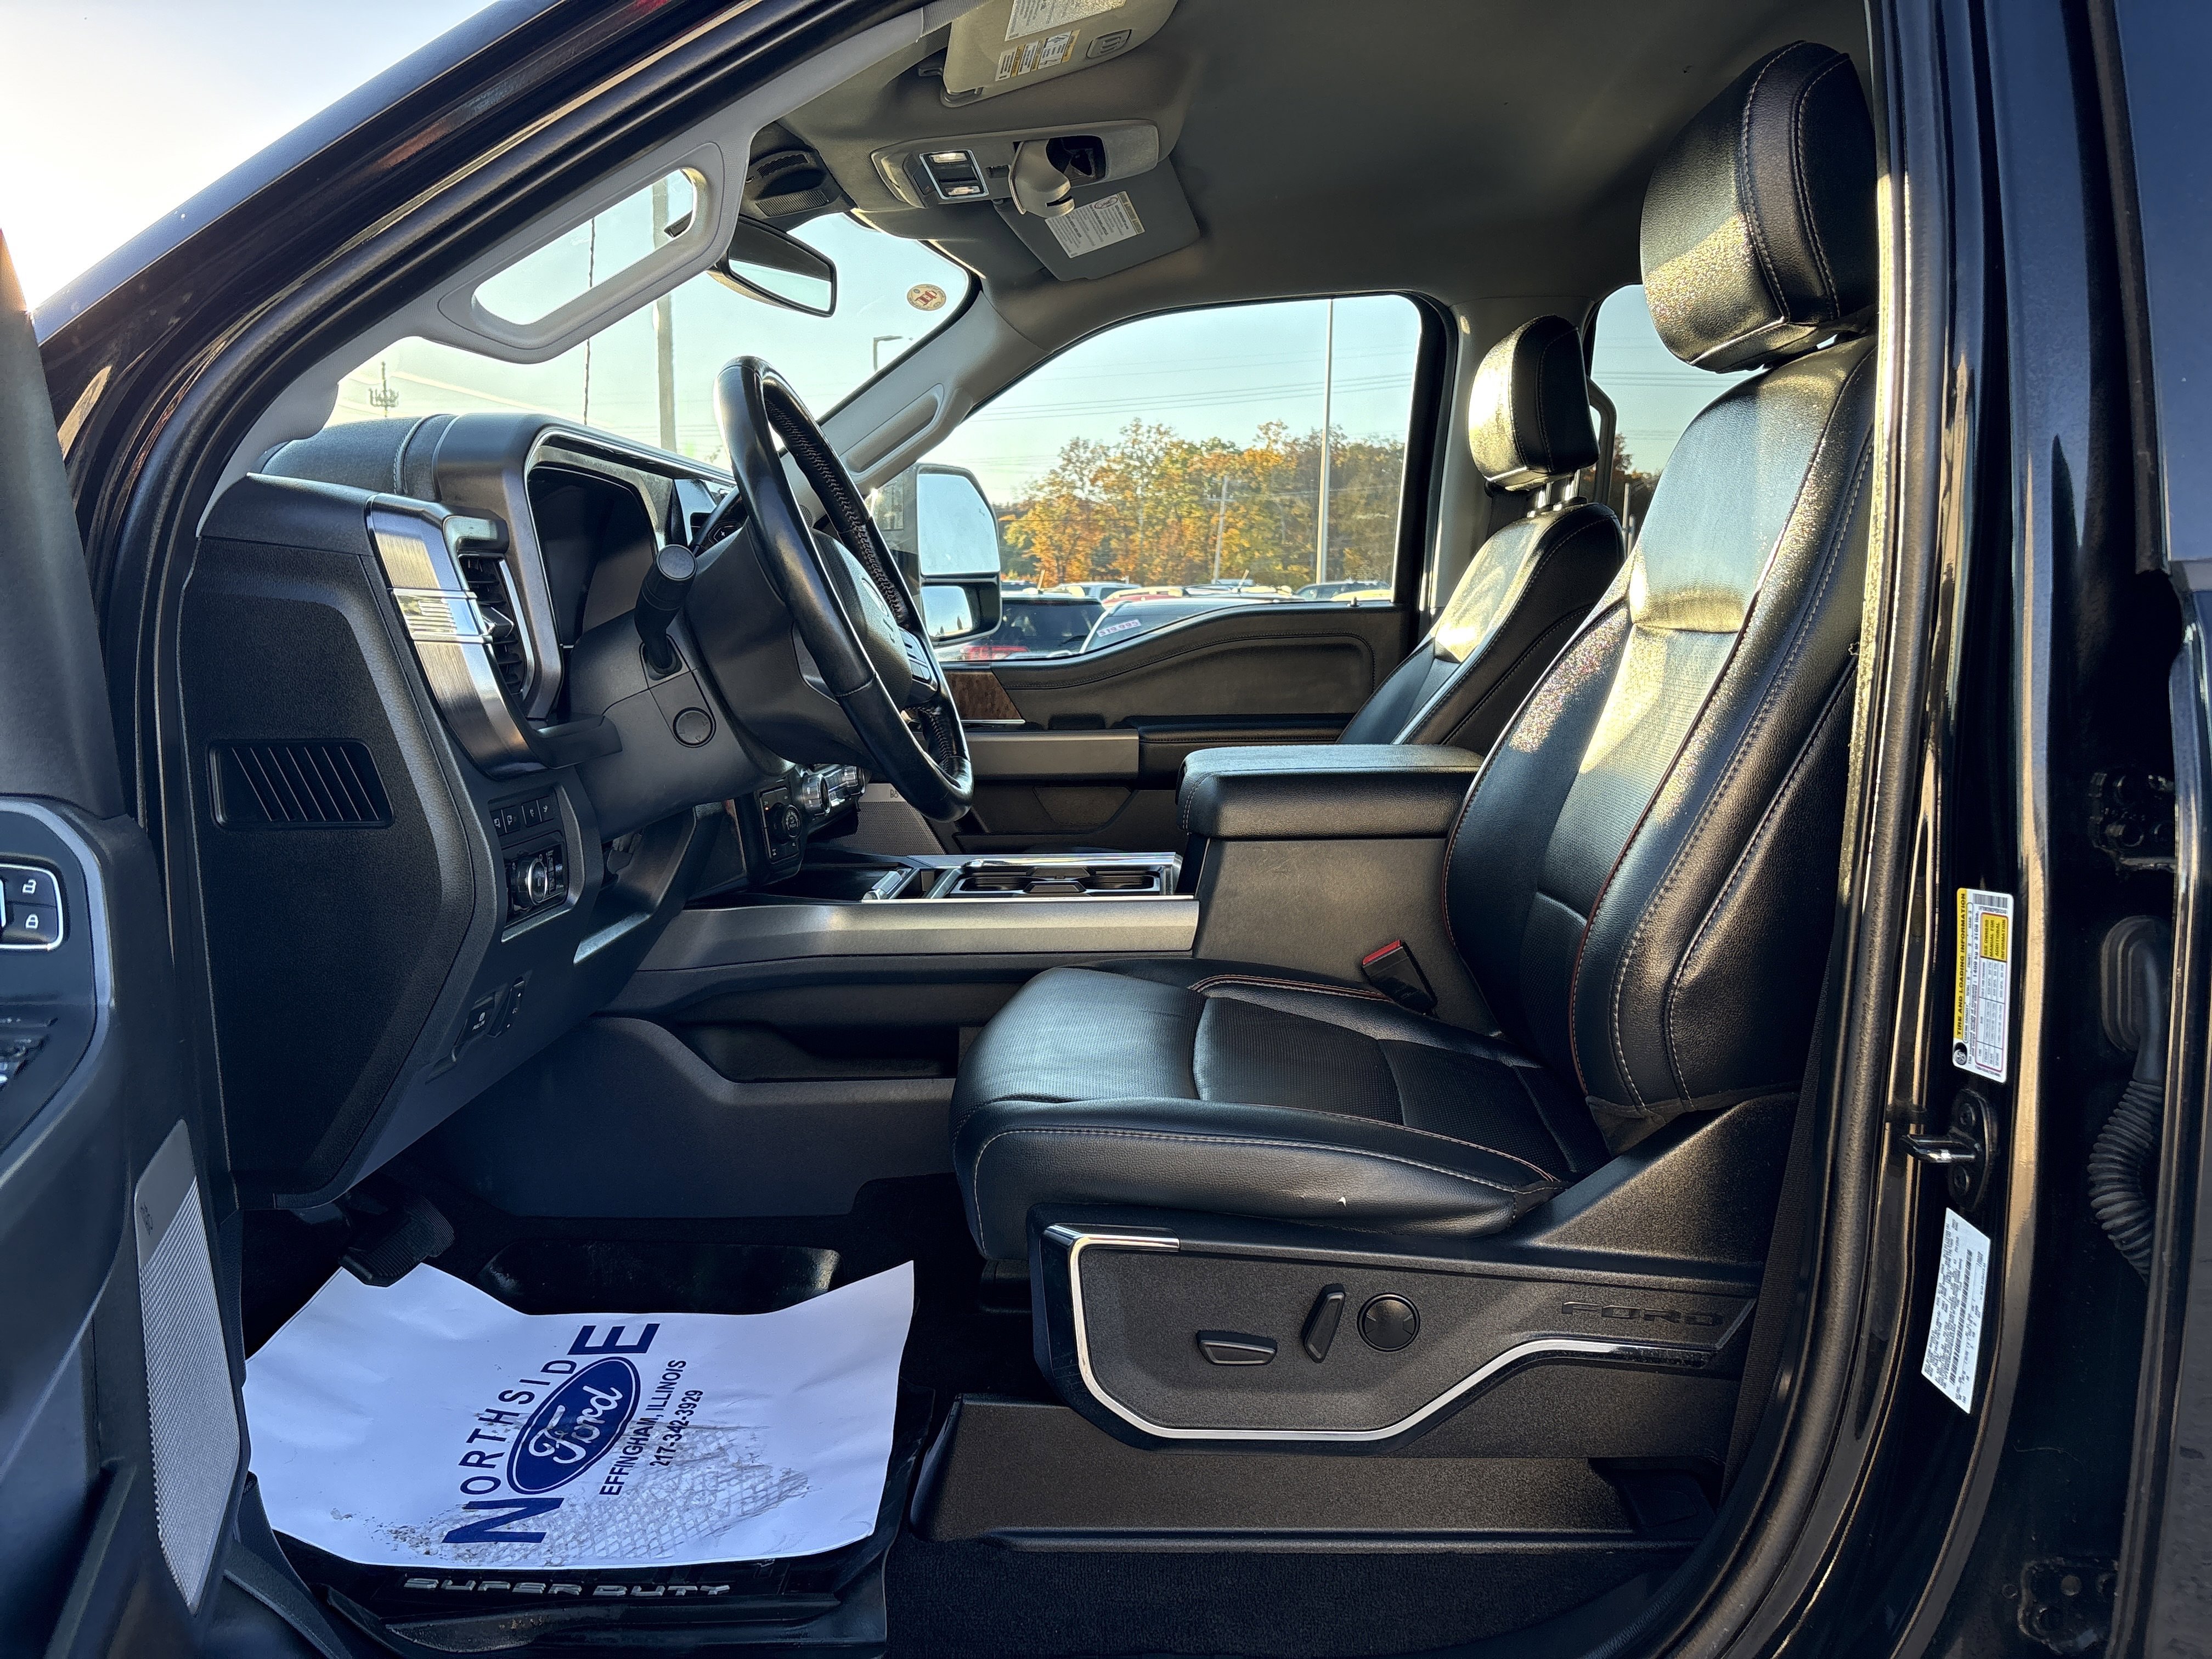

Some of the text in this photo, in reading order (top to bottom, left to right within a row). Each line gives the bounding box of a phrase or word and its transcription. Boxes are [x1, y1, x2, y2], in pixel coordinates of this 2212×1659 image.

[1561, 1300, 1724, 1326] FORD
[442, 1323, 661, 1543] NORTHSIDE
[528, 1385, 624, 1464] Ford
[599, 1359, 687, 1496] EFFINGHAM, ILLINOIS
[650, 1389, 704, 1467] 217-342-3929
[403, 1577, 730, 1596] SUPER DUTY
